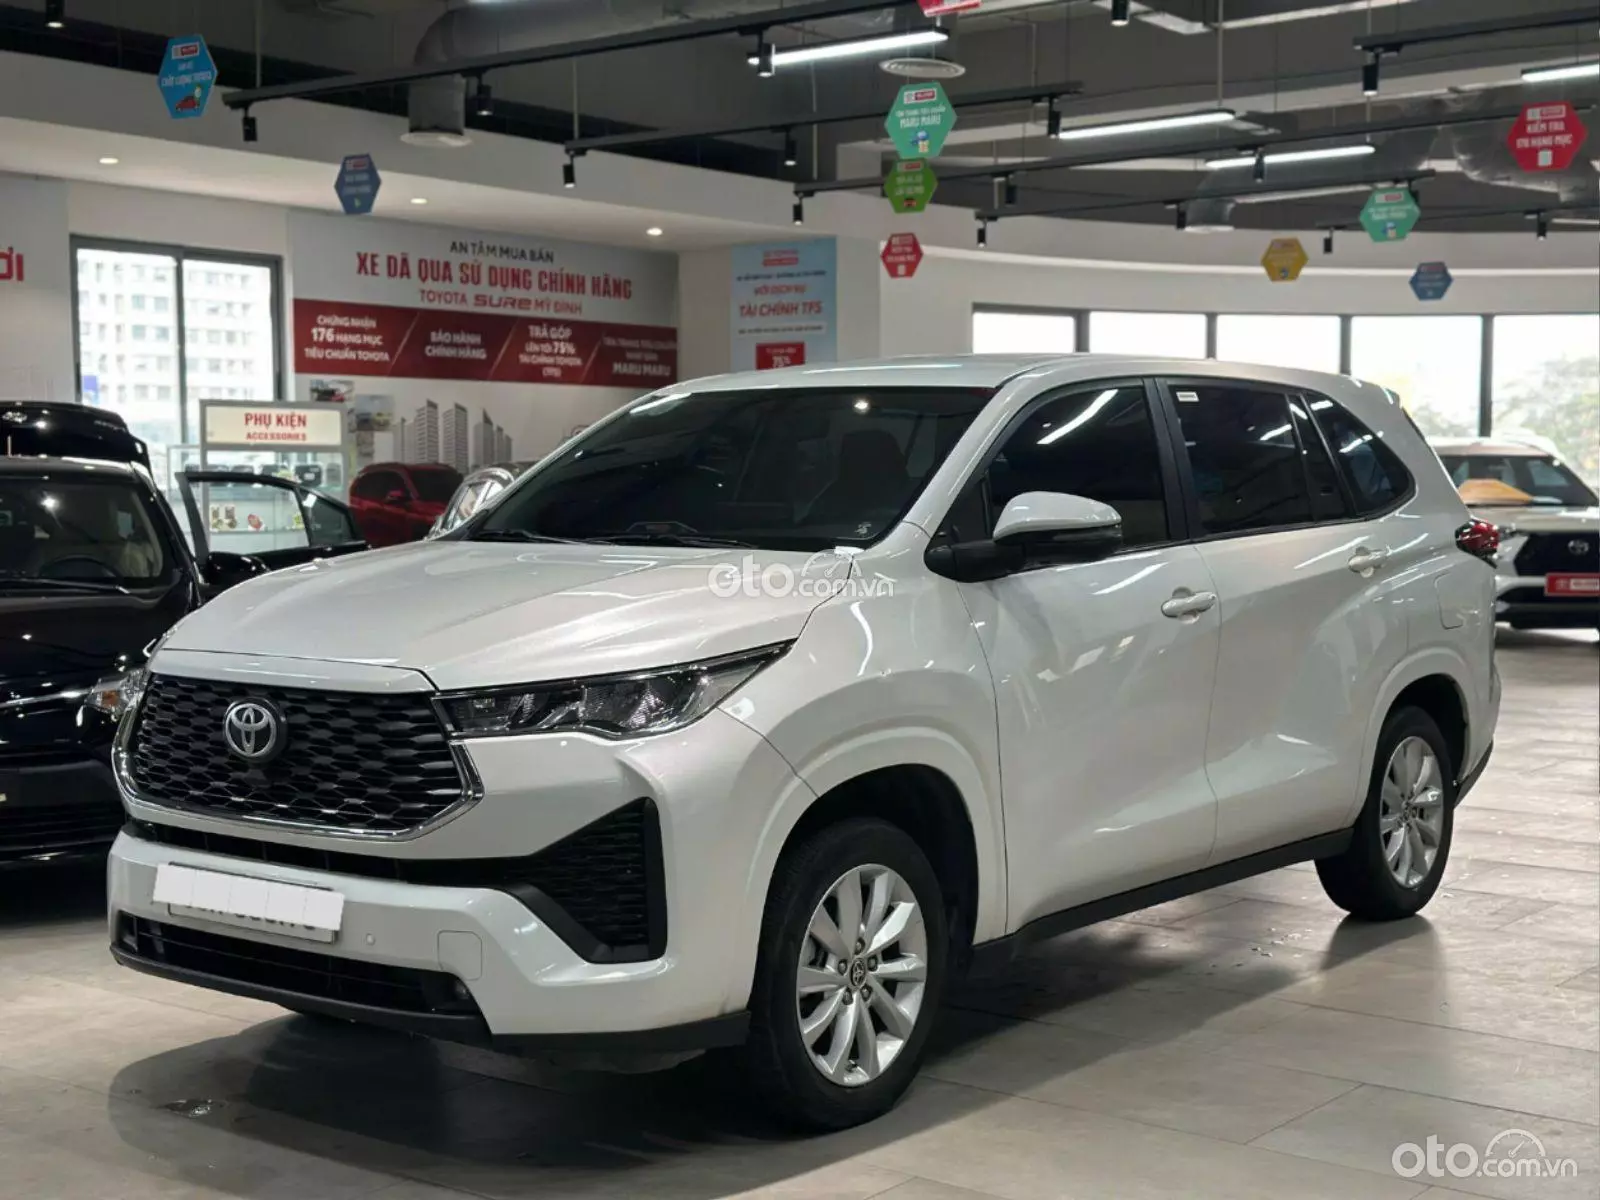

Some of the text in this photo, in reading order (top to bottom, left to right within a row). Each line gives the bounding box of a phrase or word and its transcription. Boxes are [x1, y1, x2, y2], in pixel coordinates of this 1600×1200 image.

[449, 241, 468, 254] AN
[499, 244, 527, 261] MUA
[356, 251, 380, 277] XE
[418, 258, 453, 284] QUA
[488, 265, 532, 293] DỤNG
[537, 267, 586, 296] CHÍNH
[420, 289, 467, 305] TOYOTA
[474, 293, 531, 311] SURE
[311, 327, 335, 343] 176
[358, 350, 390, 362] TOYOTA
[244, 411, 307, 430] PHỤ KIỆN
[246, 431, 307, 442] ACCESSORIES
